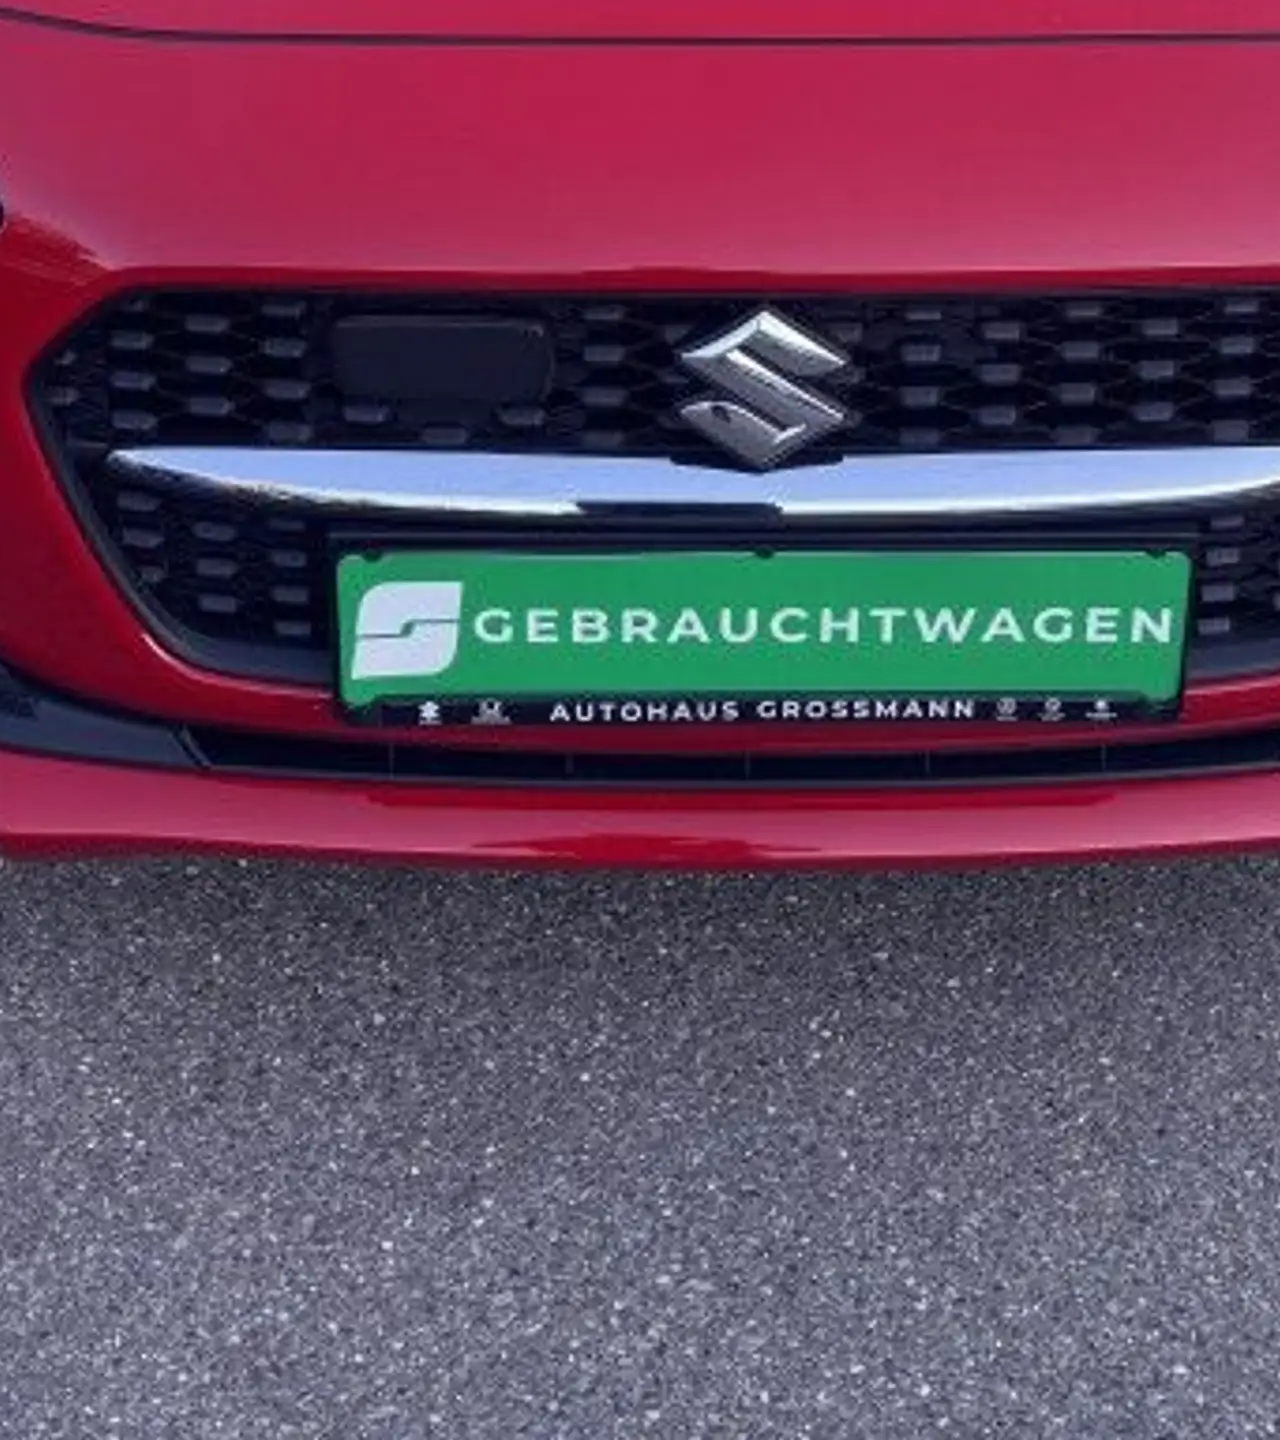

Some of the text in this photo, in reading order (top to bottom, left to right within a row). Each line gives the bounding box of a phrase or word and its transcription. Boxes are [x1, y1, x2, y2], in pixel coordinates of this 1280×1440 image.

[473, 606, 1172, 644] GEBRAUCHTWAGEN
[549, 699, 975, 722] AUTOHAUS GROSSMANN
